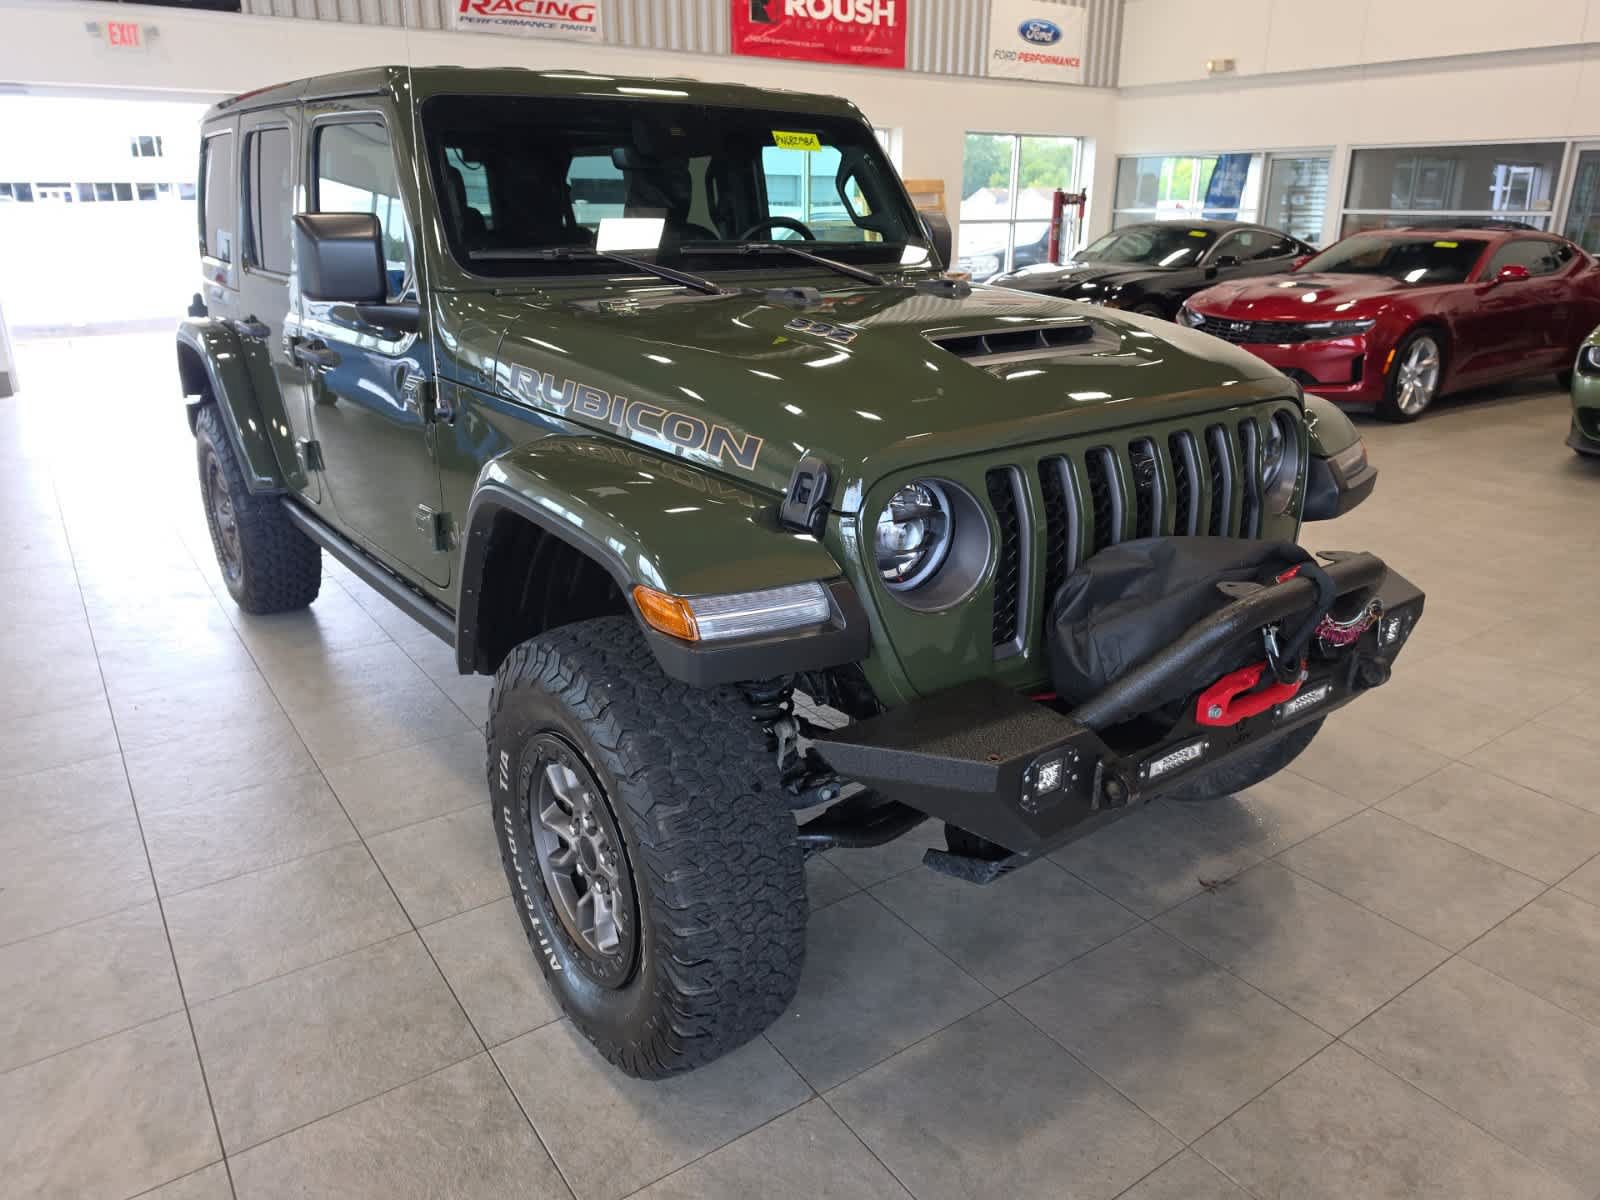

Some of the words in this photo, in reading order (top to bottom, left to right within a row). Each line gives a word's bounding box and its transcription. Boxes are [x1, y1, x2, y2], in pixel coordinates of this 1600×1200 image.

[459, 0, 596, 23] RACING
[785, 0, 895, 26] ROUSH
[108, 22, 138, 46] EXIT
[459, 16, 557, 29] PERFORMANCE
[559, 24, 597, 33] PARTS
[1026, 22, 1056, 41] Ford
[1018, 52, 1081, 68] PERFORMANCE
[509, 362, 764, 472] RUBICON
[500, 750, 511, 791] T/A
[503, 806, 563, 971] All-Terrain
